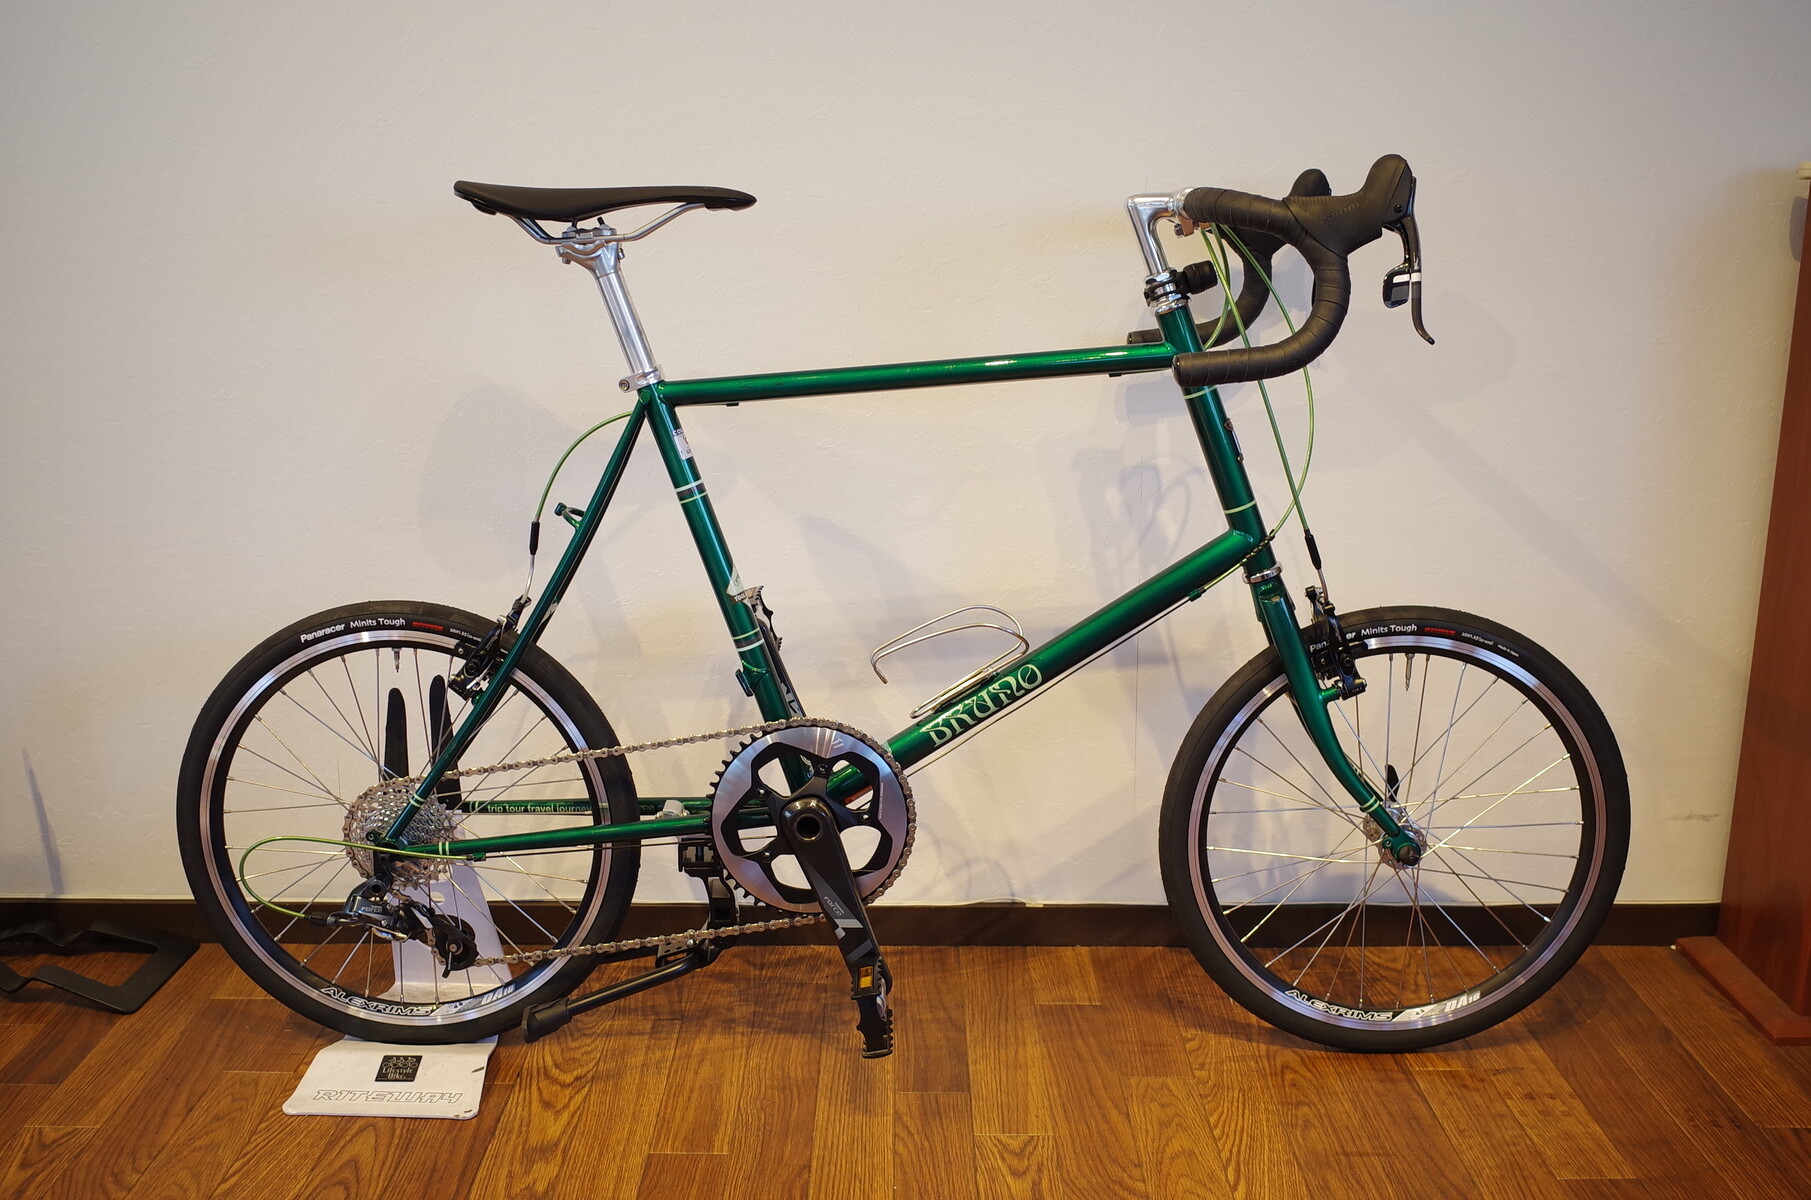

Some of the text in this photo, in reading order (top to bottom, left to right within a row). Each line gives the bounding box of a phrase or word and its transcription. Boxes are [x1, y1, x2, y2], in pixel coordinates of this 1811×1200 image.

[300, 623, 346, 643] Panaracer
[350, 618, 377, 629] Minits
[379, 617, 406, 627] Tough
[1360, 626, 1389, 637] Minits
[1389, 623, 1418, 633] Tough
[920, 664, 1042, 748] BRUNO
[487, 804, 503, 813] trip
[504, 803, 524, 813] tour
[527, 803, 553, 813] travel
[321, 986, 433, 1016] ALEXRIMS
[1285, 989, 1394, 1022] ALEXRIMS
[312, 1089, 463, 1104] RITEWAY
